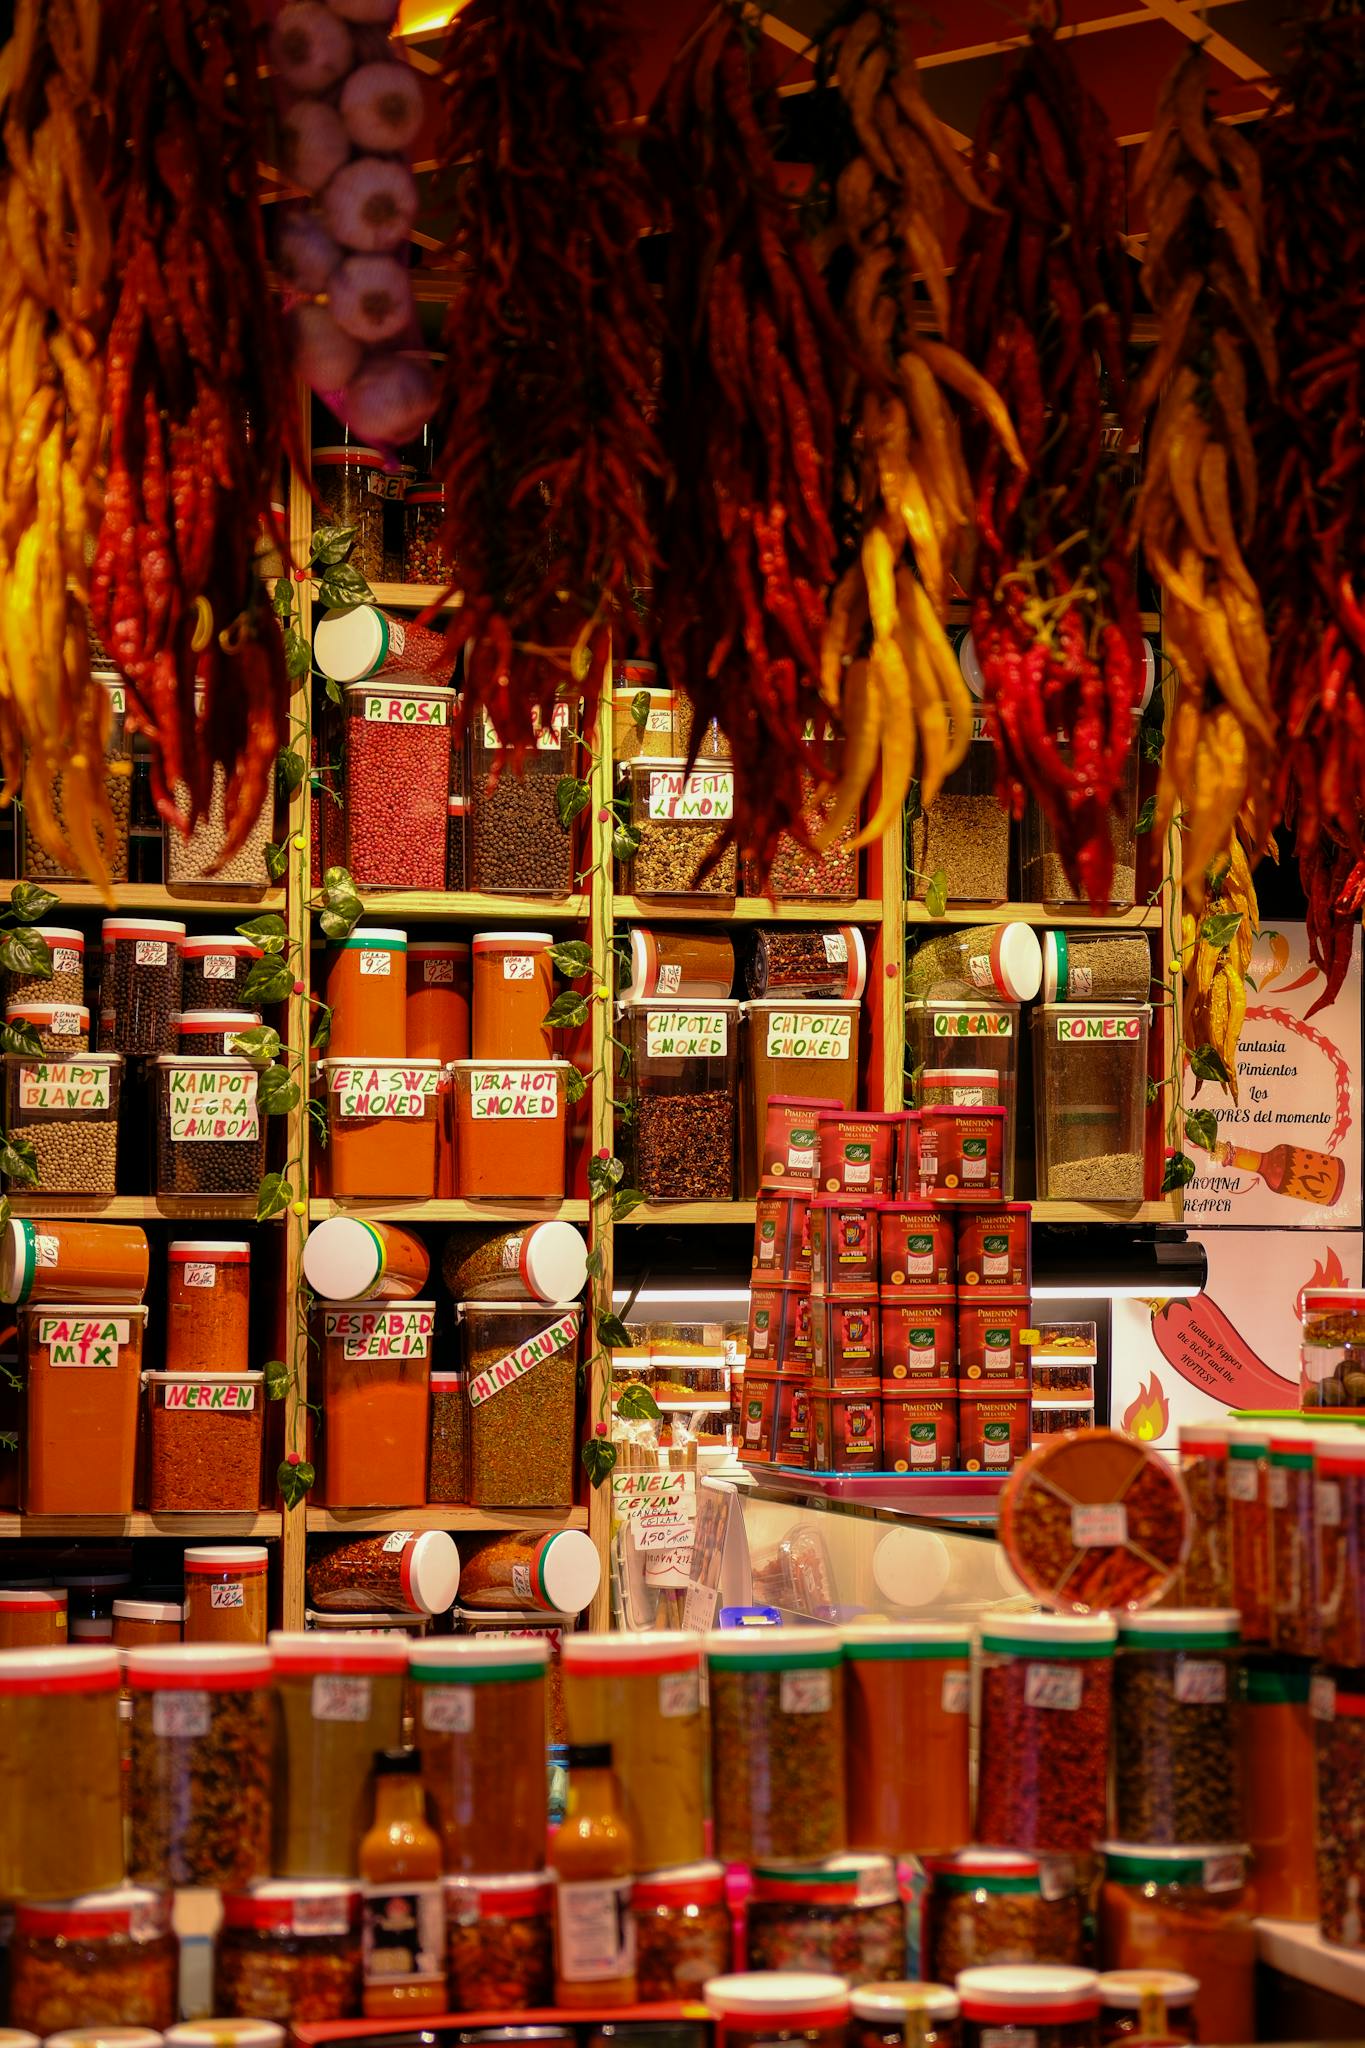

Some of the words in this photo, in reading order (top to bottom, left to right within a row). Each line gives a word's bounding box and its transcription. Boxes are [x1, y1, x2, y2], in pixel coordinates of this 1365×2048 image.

[389, 701, 442, 724] ROSA
[654, 797, 728, 818] LIMON
[648, 1013, 723, 1034] CHIPOTLE
[772, 1014, 850, 1036] CHIPOTLE
[1059, 1018, 1140, 1038] ROMERO
[652, 1038, 721, 1054] SMOKED
[771, 1038, 841, 1056] SMOKED
[1236, 1039, 1287, 1053] antasia
[24, 1067, 107, 1086] KAMPOT
[1237, 1062, 1298, 1076] Pimientos
[172, 1072, 253, 1093] KAMPOT
[27, 1088, 105, 1108] BLANCA
[346, 1094, 422, 1115] SMOKED
[1249, 1086, 1269, 1103] Los
[174, 1097, 247, 1116] NEGRA
[477, 1096, 554, 1115] SMOKED
[1253, 1110, 1273, 1123] del
[1275, 1112, 1332, 1124] momento
[173, 1118, 258, 1138] CAMBOYA
[1184, 1199, 1232, 1212] REAPER
[43, 1321, 117, 1343] PAELLA
[54, 1342, 112, 1365] MIX
[346, 1335, 425, 1356] ESENCIA
[1188, 1319, 1216, 1348] Fantasy
[1216, 1343, 1243, 1370] Peppers
[469, 1311, 579, 1404] CHIMICHURRI
[1177, 1331, 1190, 1344] the
[1189, 1340, 1213, 1361] BEST
[1208, 1358, 1226, 1375] and
[1222, 1370, 1236, 1383] the
[1181, 1353, 1217, 1385] HOTTEST
[167, 1386, 251, 1408] MERKEN
[613, 1473, 686, 1494] CANELA
[618, 1495, 680, 1511] CEYLAN
